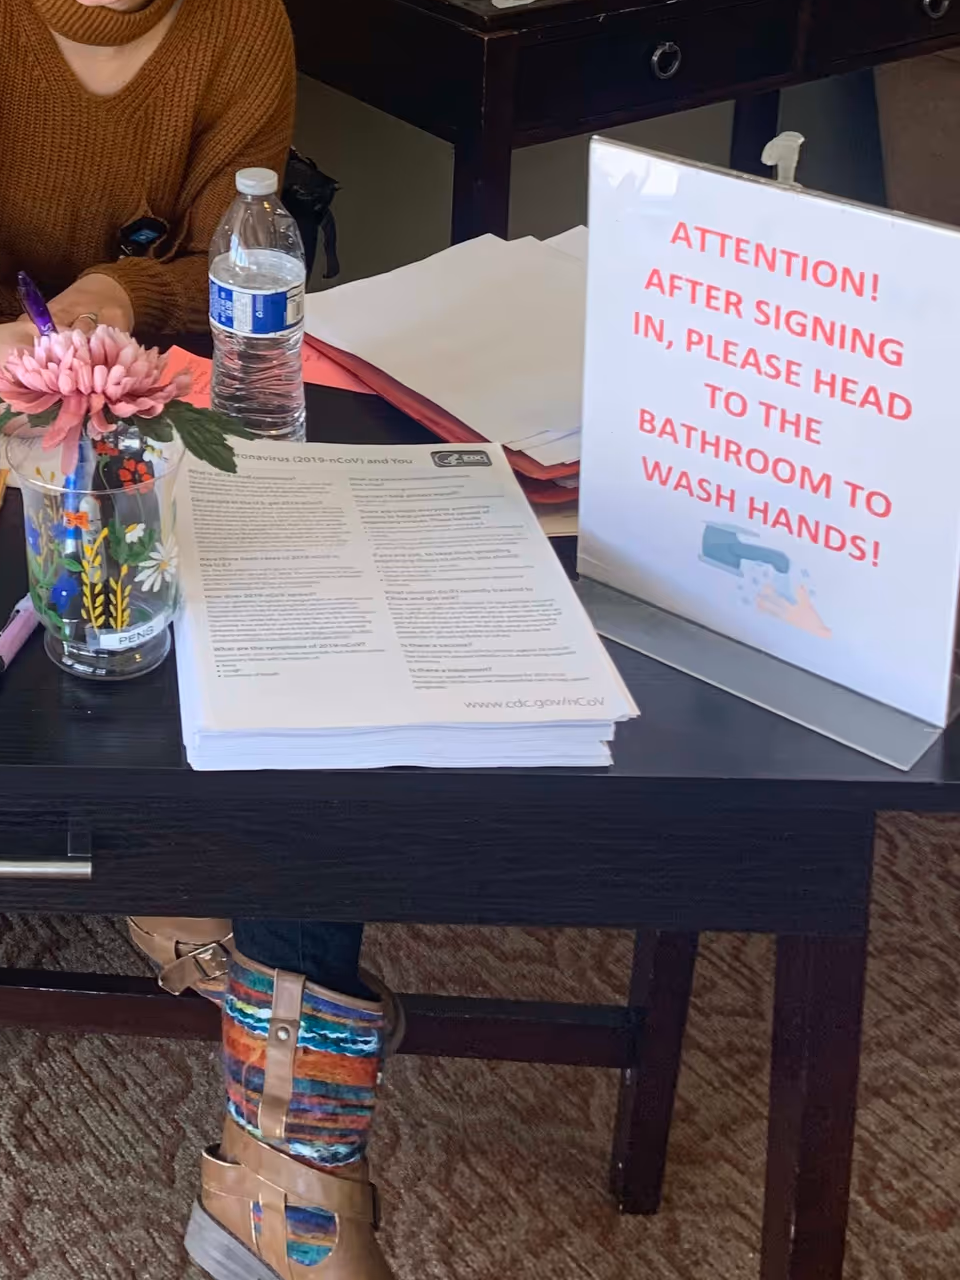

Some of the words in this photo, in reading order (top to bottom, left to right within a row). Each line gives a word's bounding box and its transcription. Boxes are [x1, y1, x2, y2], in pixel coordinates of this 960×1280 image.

[670, 220, 881, 302] ATTENTION!
[644, 268, 743, 320] AFTER
[754, 298, 905, 368] SIGNING
[632, 311, 675, 351] IN,
[686, 327, 801, 387] PLEASE
[814, 369, 913, 421] HEAD
[704, 382, 747, 419] TO
[759, 400, 823, 445] THE
[292, 455, 364, 465] (2019-nCoV)
[367, 457, 389, 465] and
[390, 457, 413, 465] You
[637, 407, 832, 501] BATHROOM
[845, 479, 893, 520] TO
[641, 455, 736, 513] WASH
[747, 495, 881, 568] HANDS!
[119, 625, 154, 646] PENS
[464, 697, 605, 709] www.cdc.gov/nCoV
